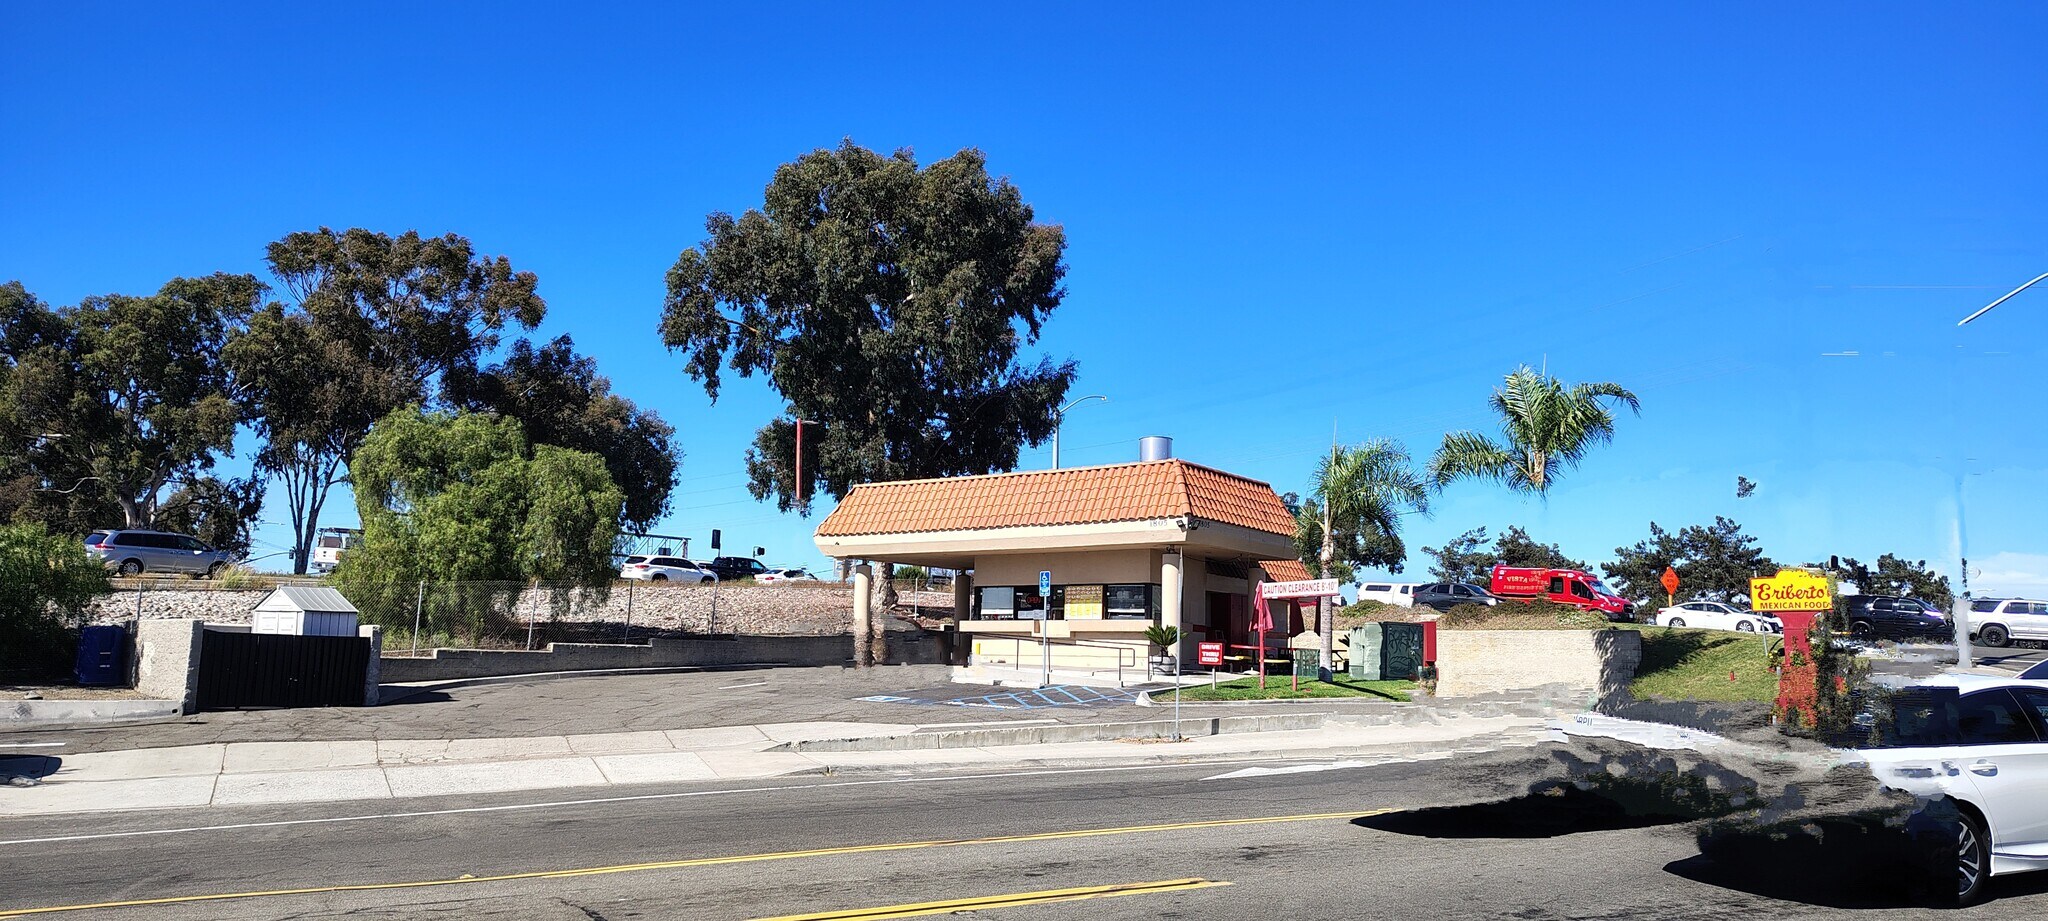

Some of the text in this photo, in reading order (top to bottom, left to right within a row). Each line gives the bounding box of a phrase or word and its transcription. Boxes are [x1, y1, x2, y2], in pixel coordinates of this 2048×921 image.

[1149, 519, 1168, 528] 1805
[1506, 575, 1528, 583] VISTA
[1264, 584, 1287, 595] CAUTION
[1288, 582, 1320, 593] CLEARANCE
[1804, 601, 1829, 609] FOOD
